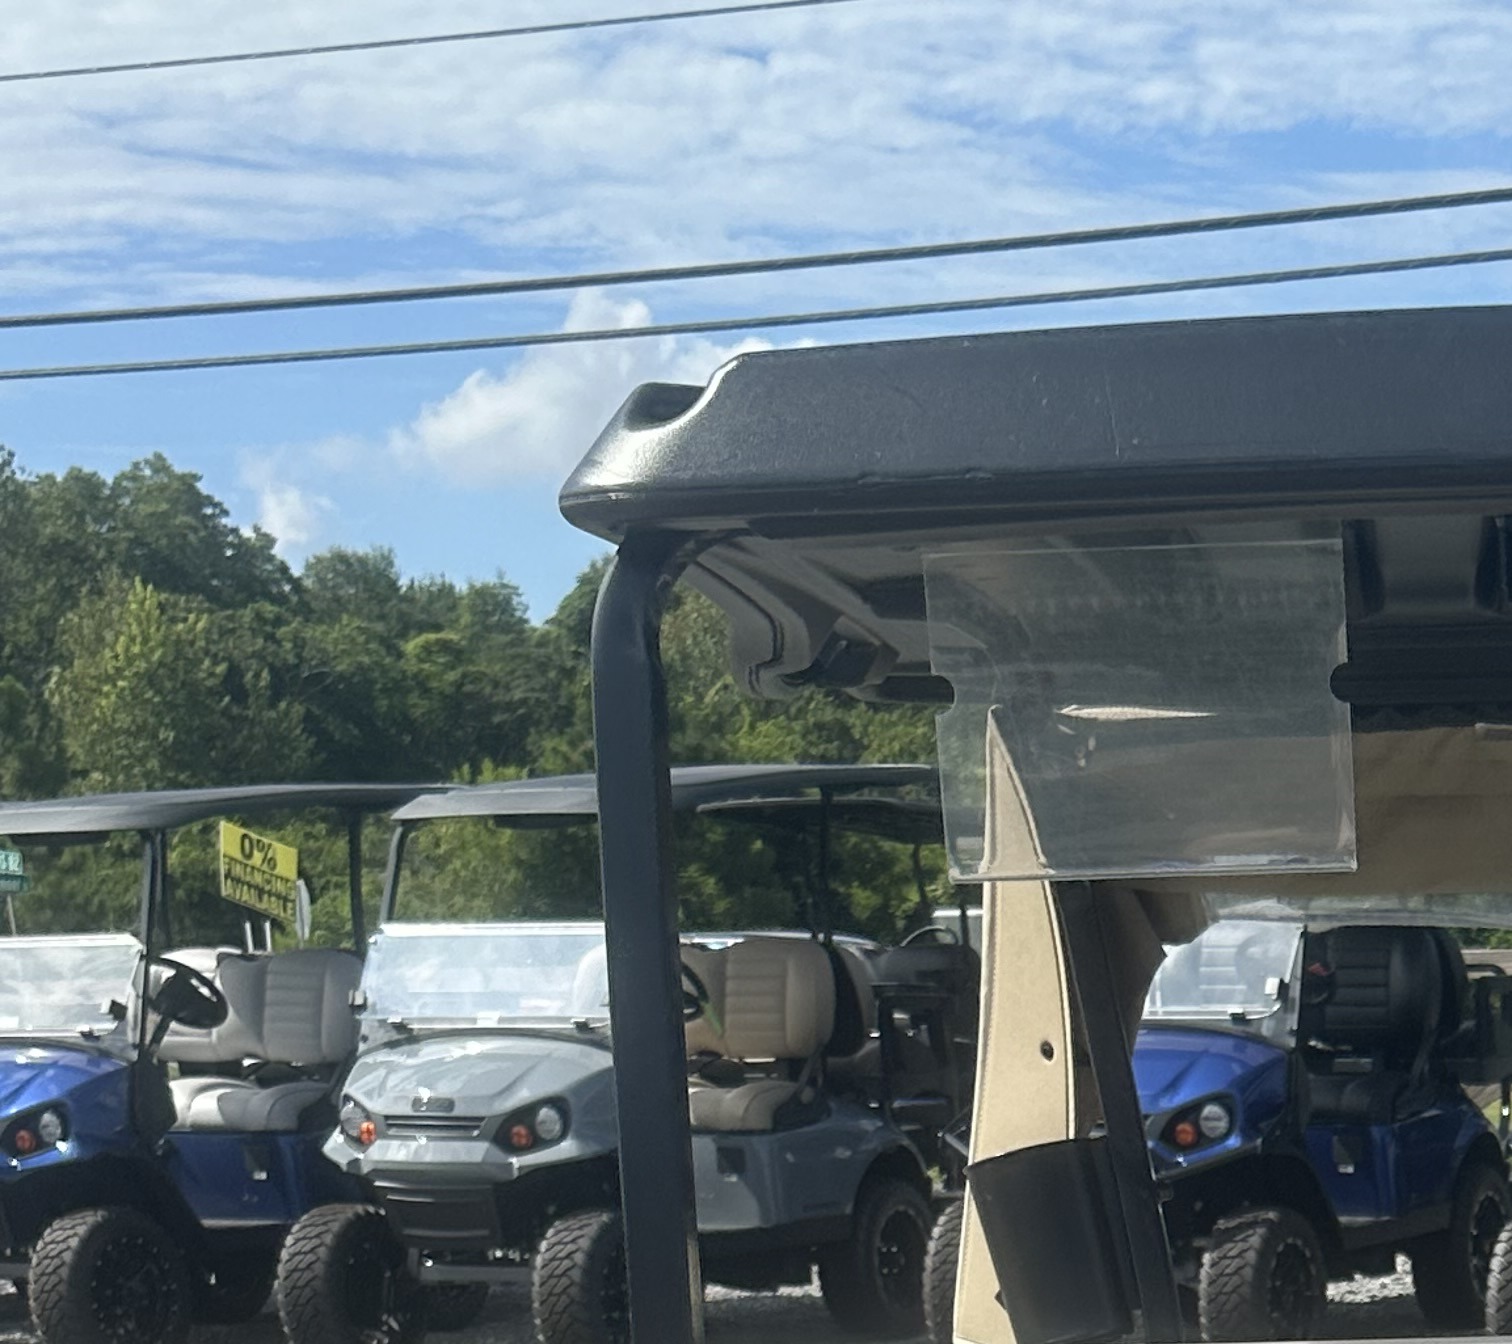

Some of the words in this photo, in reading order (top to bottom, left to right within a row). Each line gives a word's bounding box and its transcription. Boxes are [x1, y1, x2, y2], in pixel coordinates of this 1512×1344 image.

[241, 833, 278, 873] 0%
[223, 857, 297, 901] FINANCING
[223, 876, 297, 921] AVAILABLE
